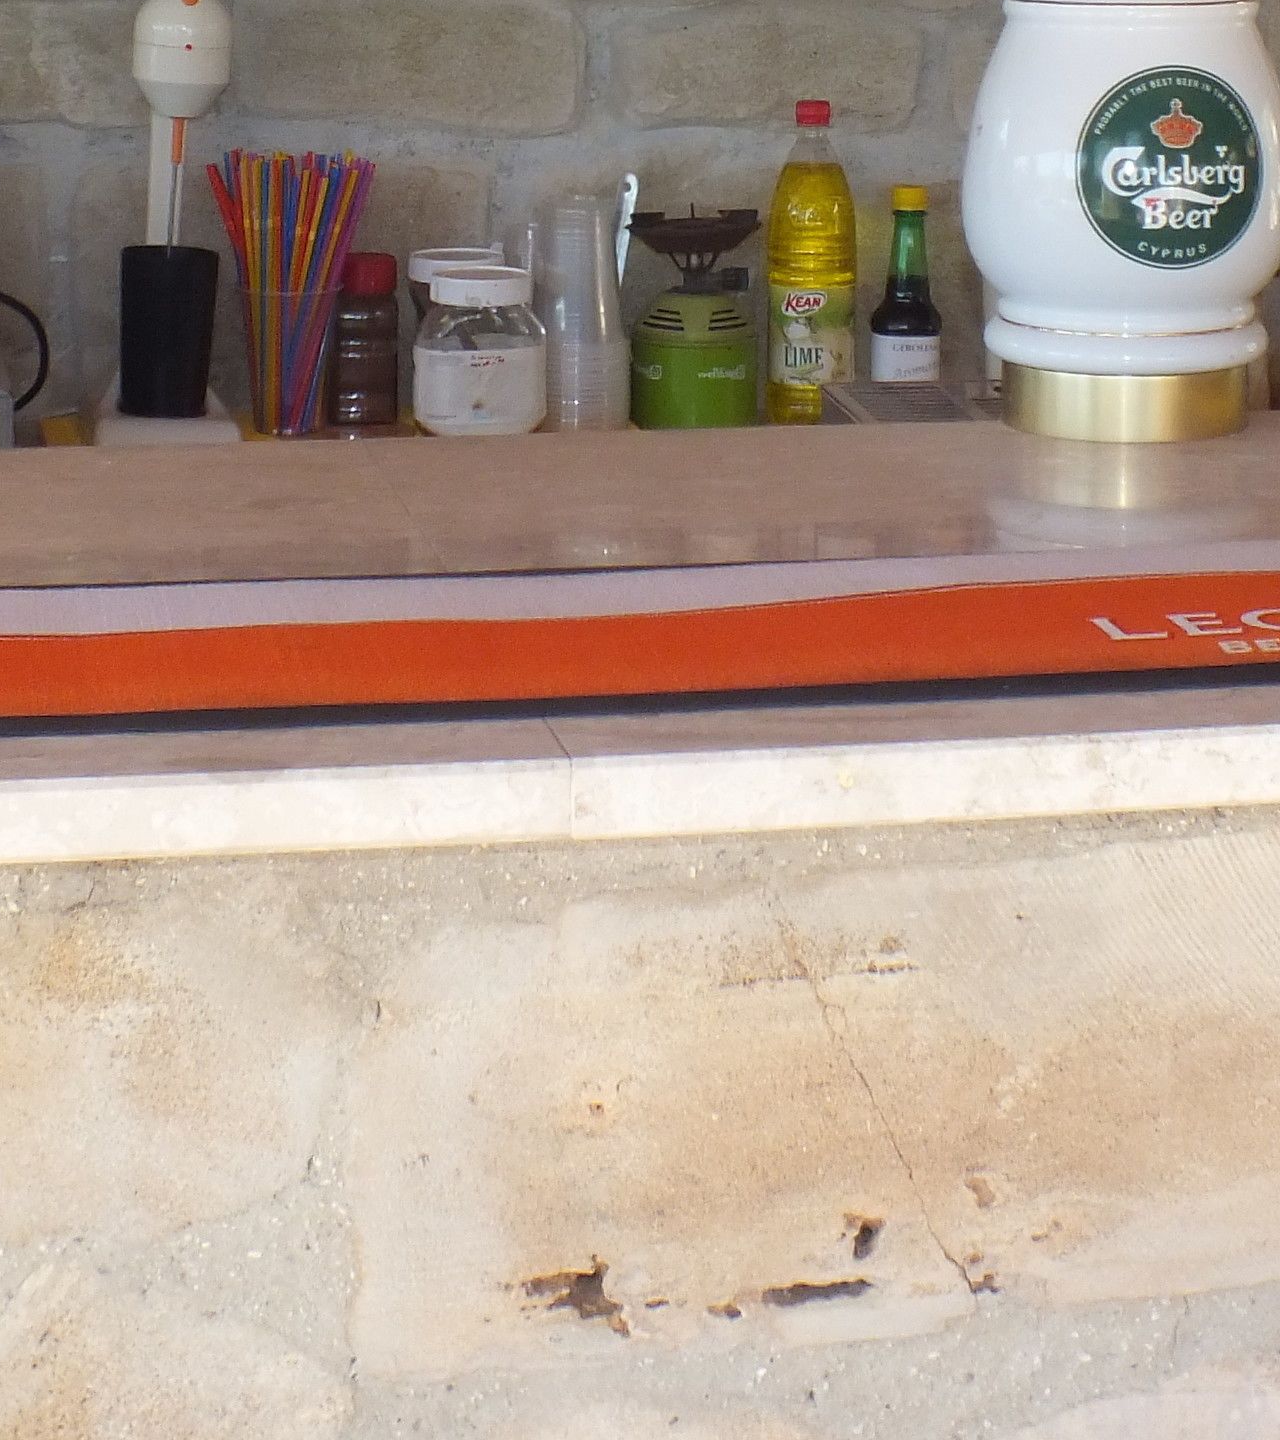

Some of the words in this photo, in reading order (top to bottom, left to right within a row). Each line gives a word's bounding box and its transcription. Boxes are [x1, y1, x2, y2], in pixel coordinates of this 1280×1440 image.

[1093, 93, 1130, 136] PROBABLY
[1129, 83, 1148, 97] THE
[1148, 77, 1173, 90] BEST
[1175, 77, 1200, 89] BEER
[1101, 144, 1246, 197] Carlsberg
[1141, 196, 1219, 230] Beer
[1136, 241, 1208, 260] CYPRUS
[783, 291, 823, 313] KEAN
[784, 345, 825, 370] LIME
